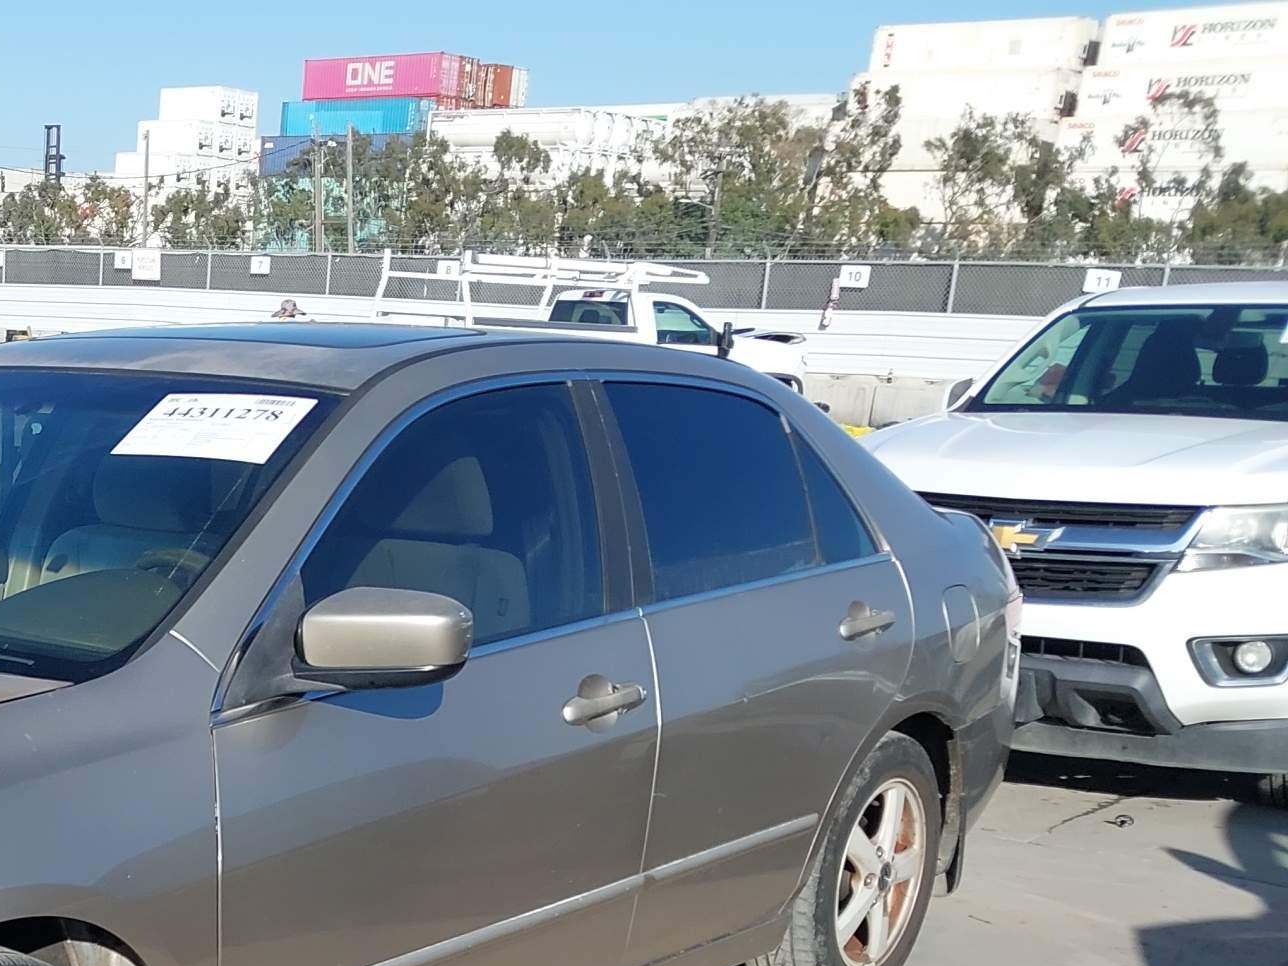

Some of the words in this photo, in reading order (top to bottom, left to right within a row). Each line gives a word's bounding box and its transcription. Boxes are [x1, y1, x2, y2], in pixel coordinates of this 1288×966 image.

[1200, 17, 1278, 35] HORIZON
[345, 60, 396, 86] ONE
[1175, 73, 1252, 88] HORIZON
[848, 271, 862, 282] 10
[1096, 276, 1112, 289] 11
[162, 407, 283, 422] 44311278
